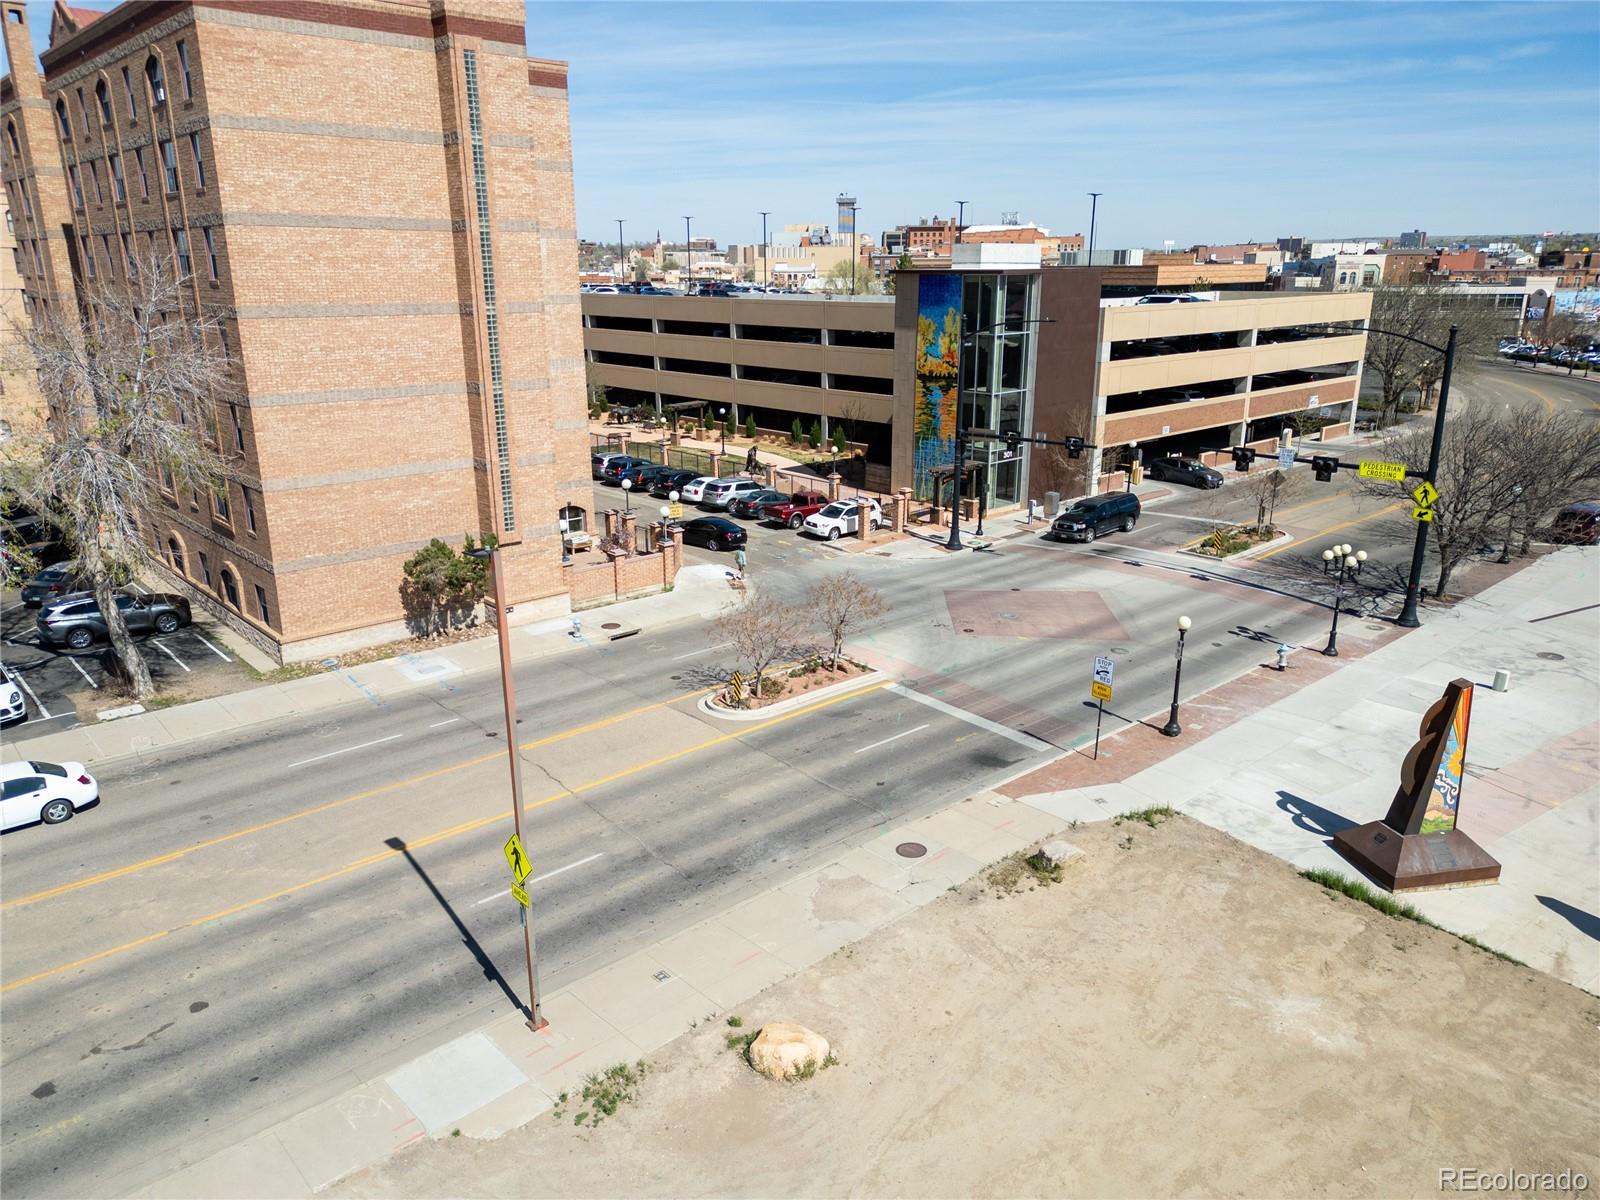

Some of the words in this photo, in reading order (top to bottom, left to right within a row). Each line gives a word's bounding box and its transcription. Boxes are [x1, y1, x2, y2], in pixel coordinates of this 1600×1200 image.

[1363, 462, 1402, 473] PEDESTRIAN
[1366, 470, 1397, 479] CROSSING
[1097, 658, 1112, 667] STOP
